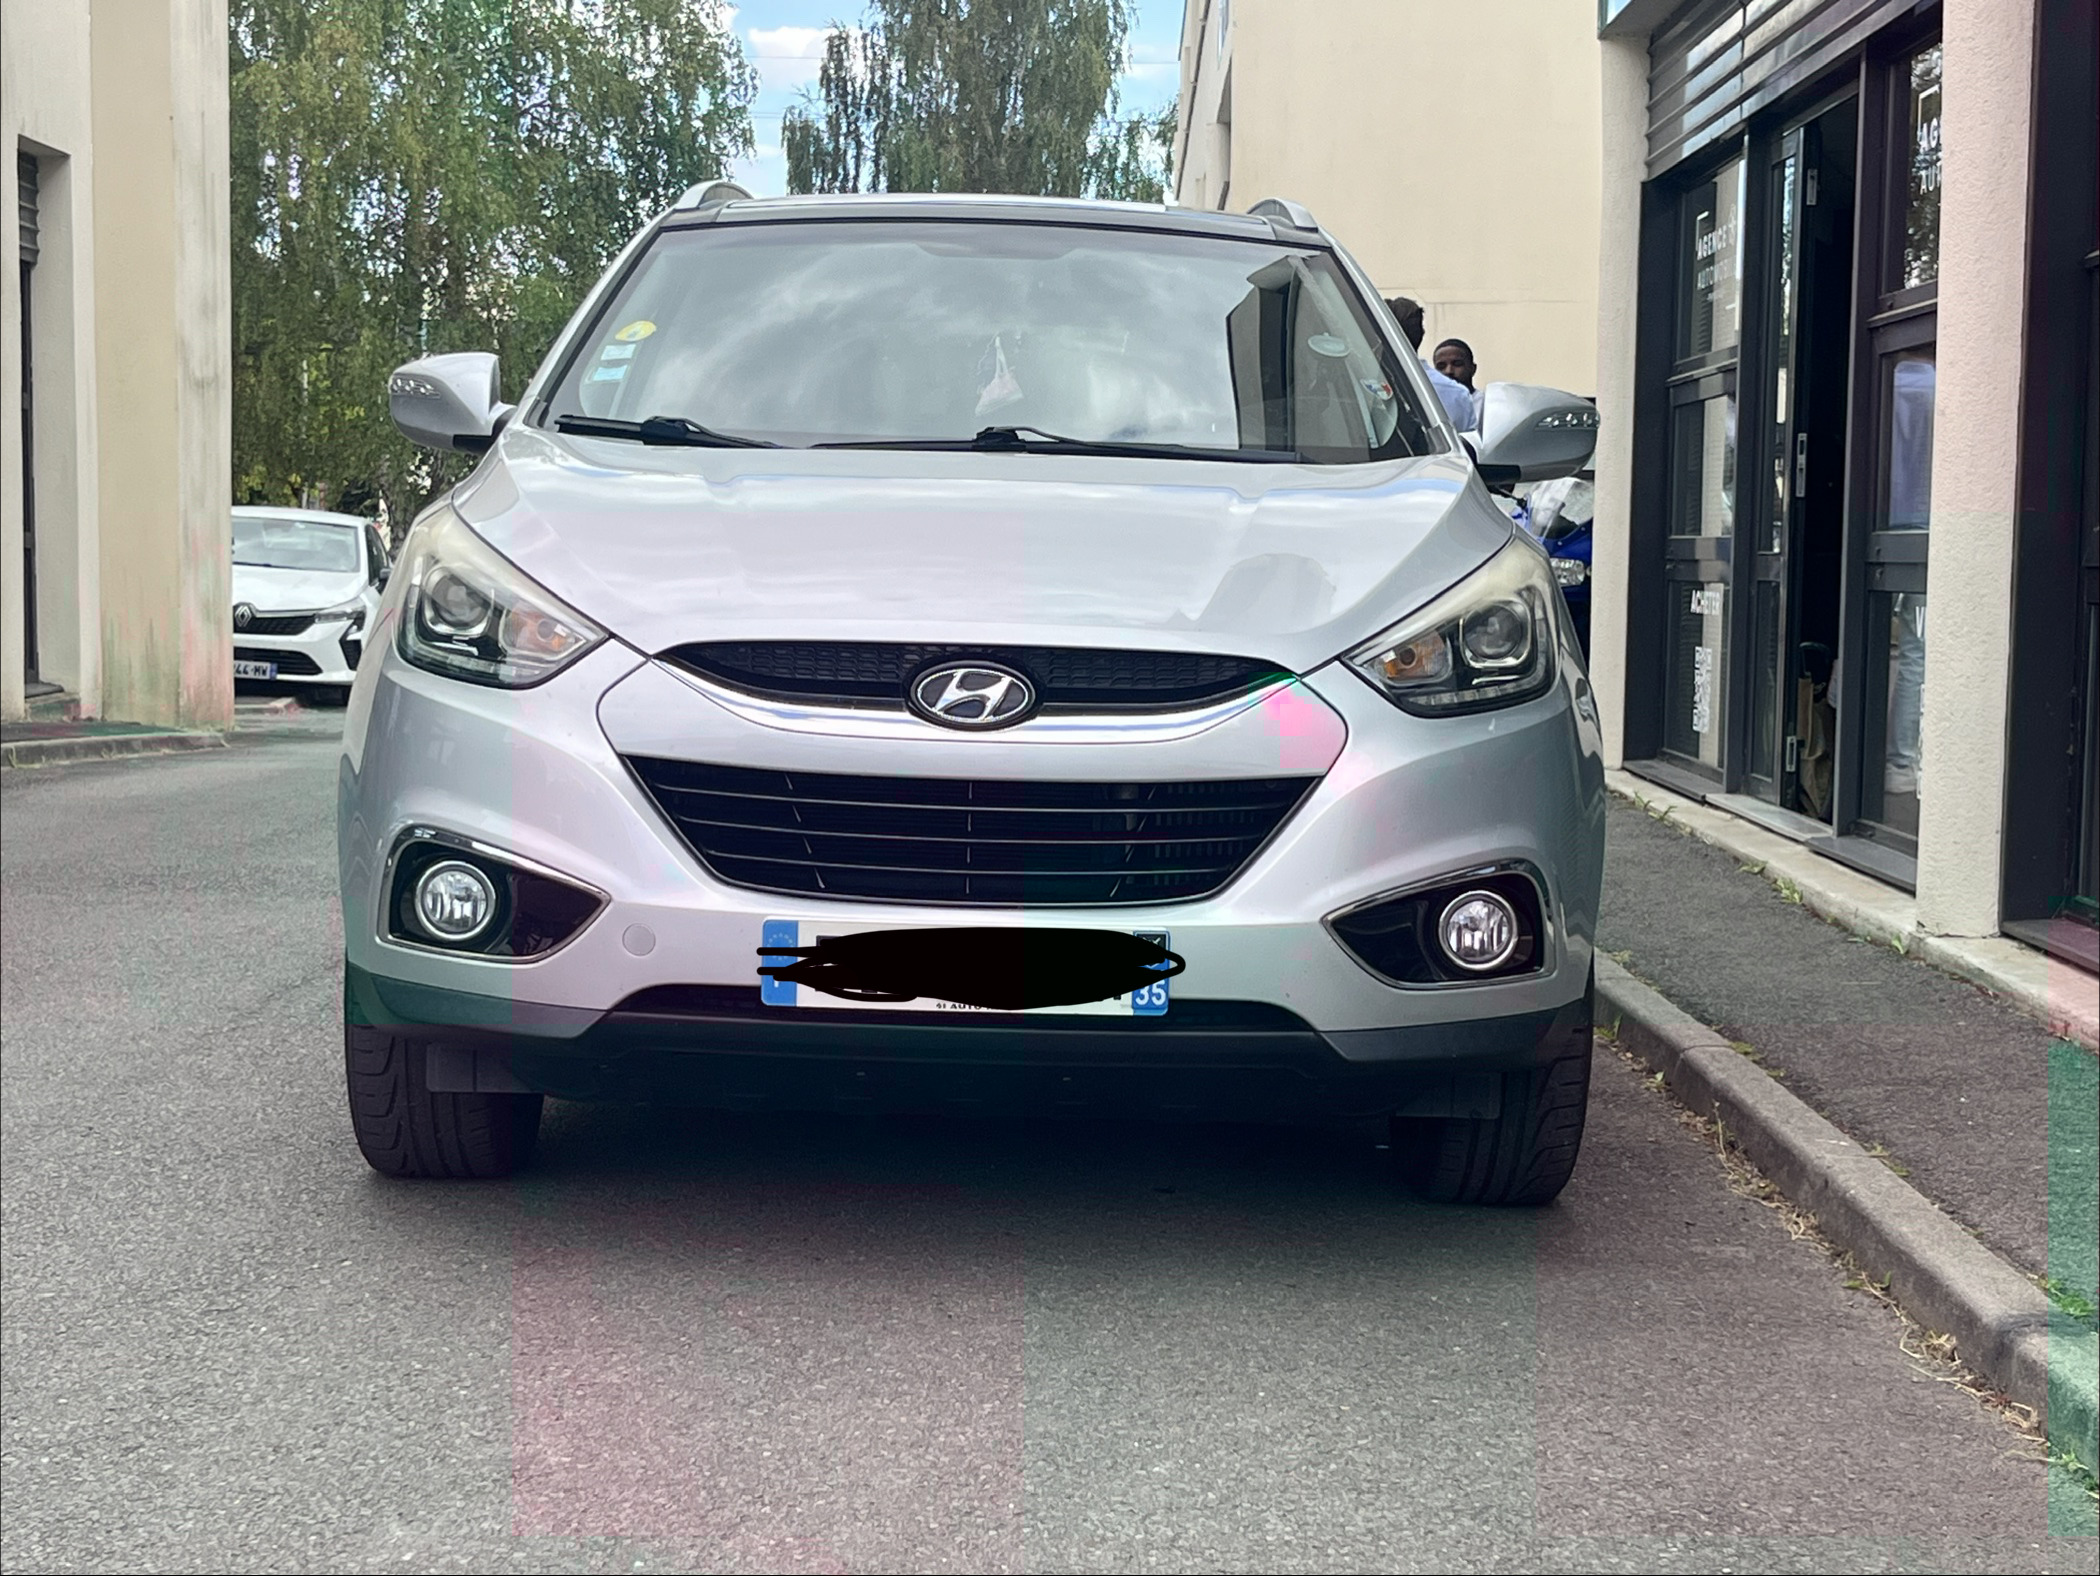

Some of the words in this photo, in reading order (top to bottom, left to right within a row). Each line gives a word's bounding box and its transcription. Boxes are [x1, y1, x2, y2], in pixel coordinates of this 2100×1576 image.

[1697, 224, 1727, 260] AGENCE
[1690, 589, 1720, 616] ACHETER
[234, 663, 269, 676] 44-MW
[1135, 979, 1167, 1006] 35
